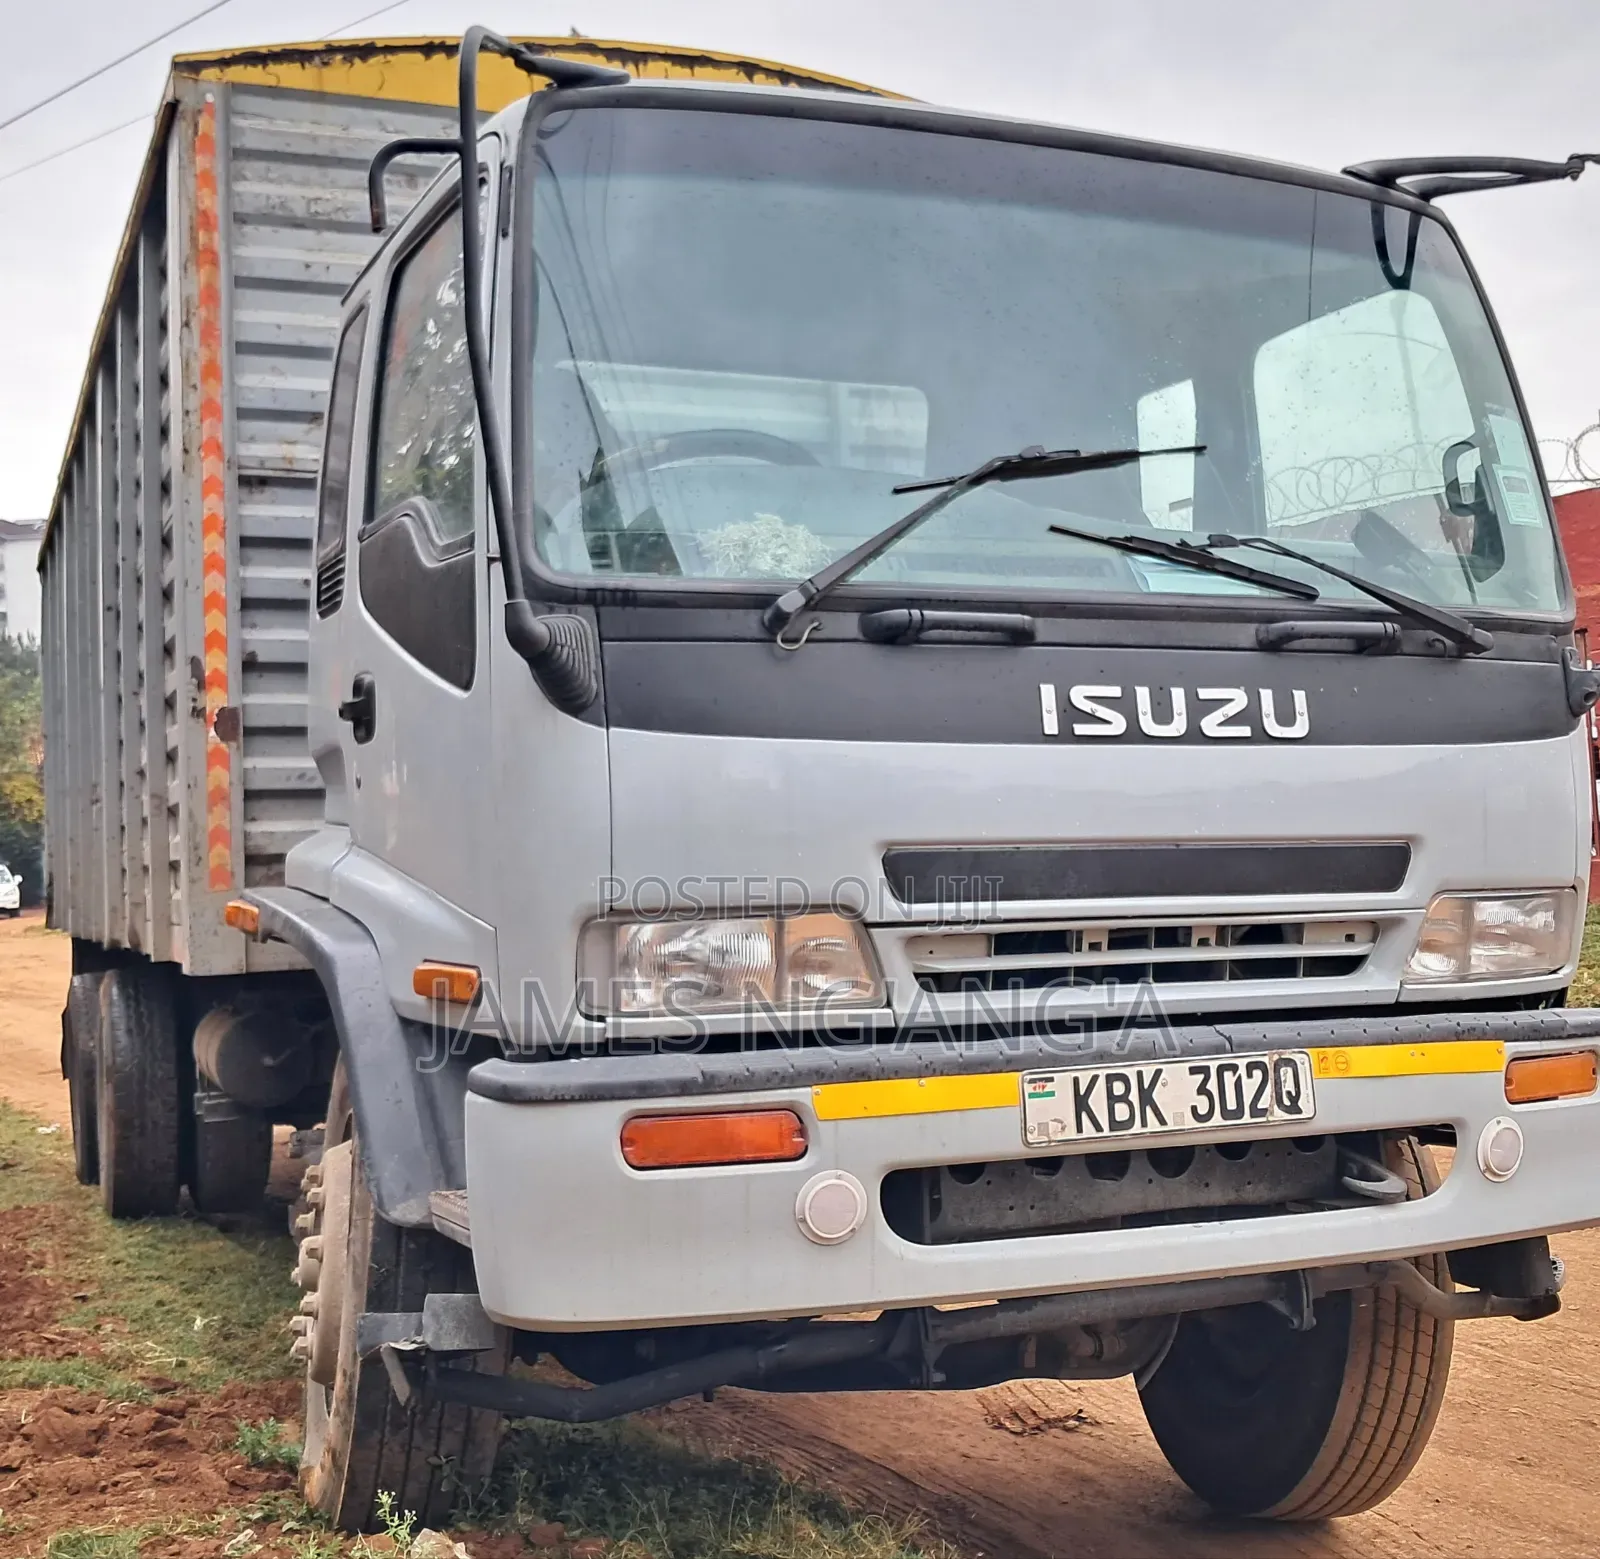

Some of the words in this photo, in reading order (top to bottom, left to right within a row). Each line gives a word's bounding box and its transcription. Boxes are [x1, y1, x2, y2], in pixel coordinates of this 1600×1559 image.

[1039, 683, 1310, 739] ISUZU
[1072, 1067, 1169, 1134] KBK
[1188, 1057, 1304, 1124] 302Q
